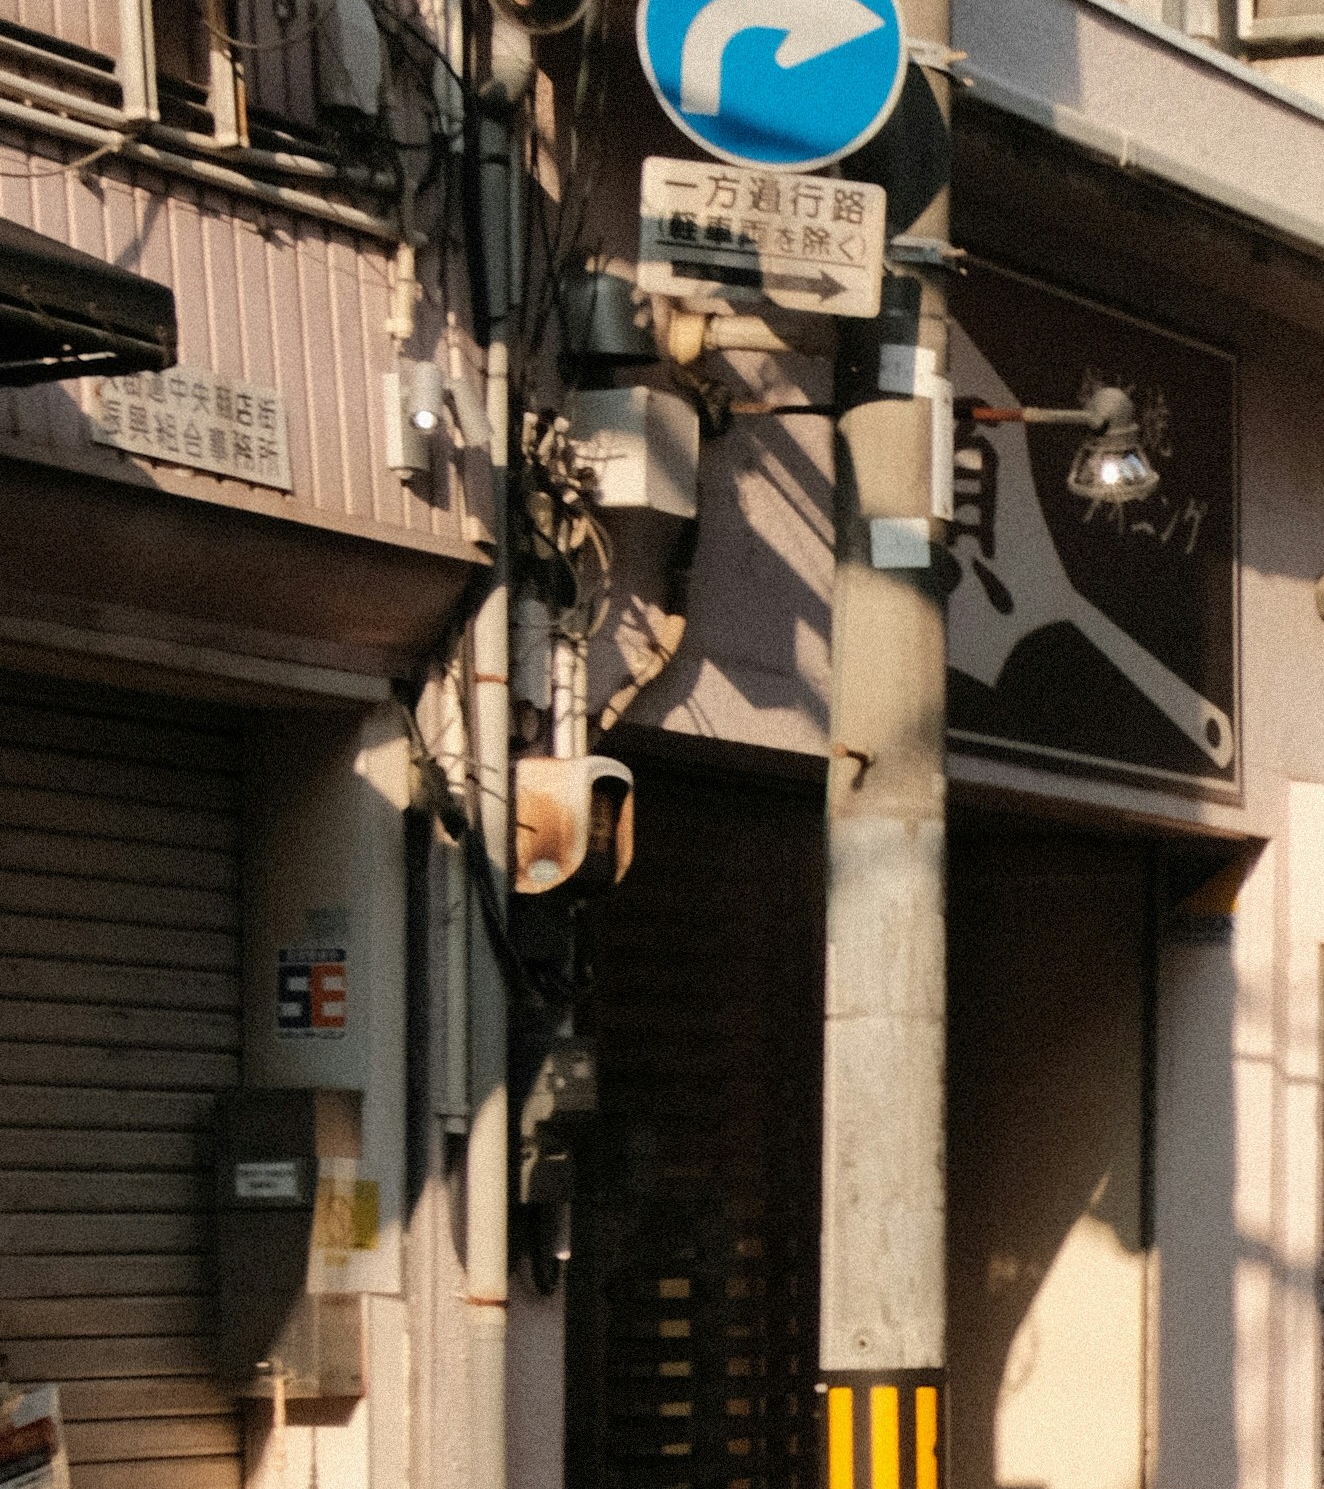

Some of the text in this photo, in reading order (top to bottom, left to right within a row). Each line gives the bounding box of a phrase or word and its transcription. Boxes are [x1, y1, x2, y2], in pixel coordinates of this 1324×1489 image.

[664, 172, 865, 225] 一方通行路
